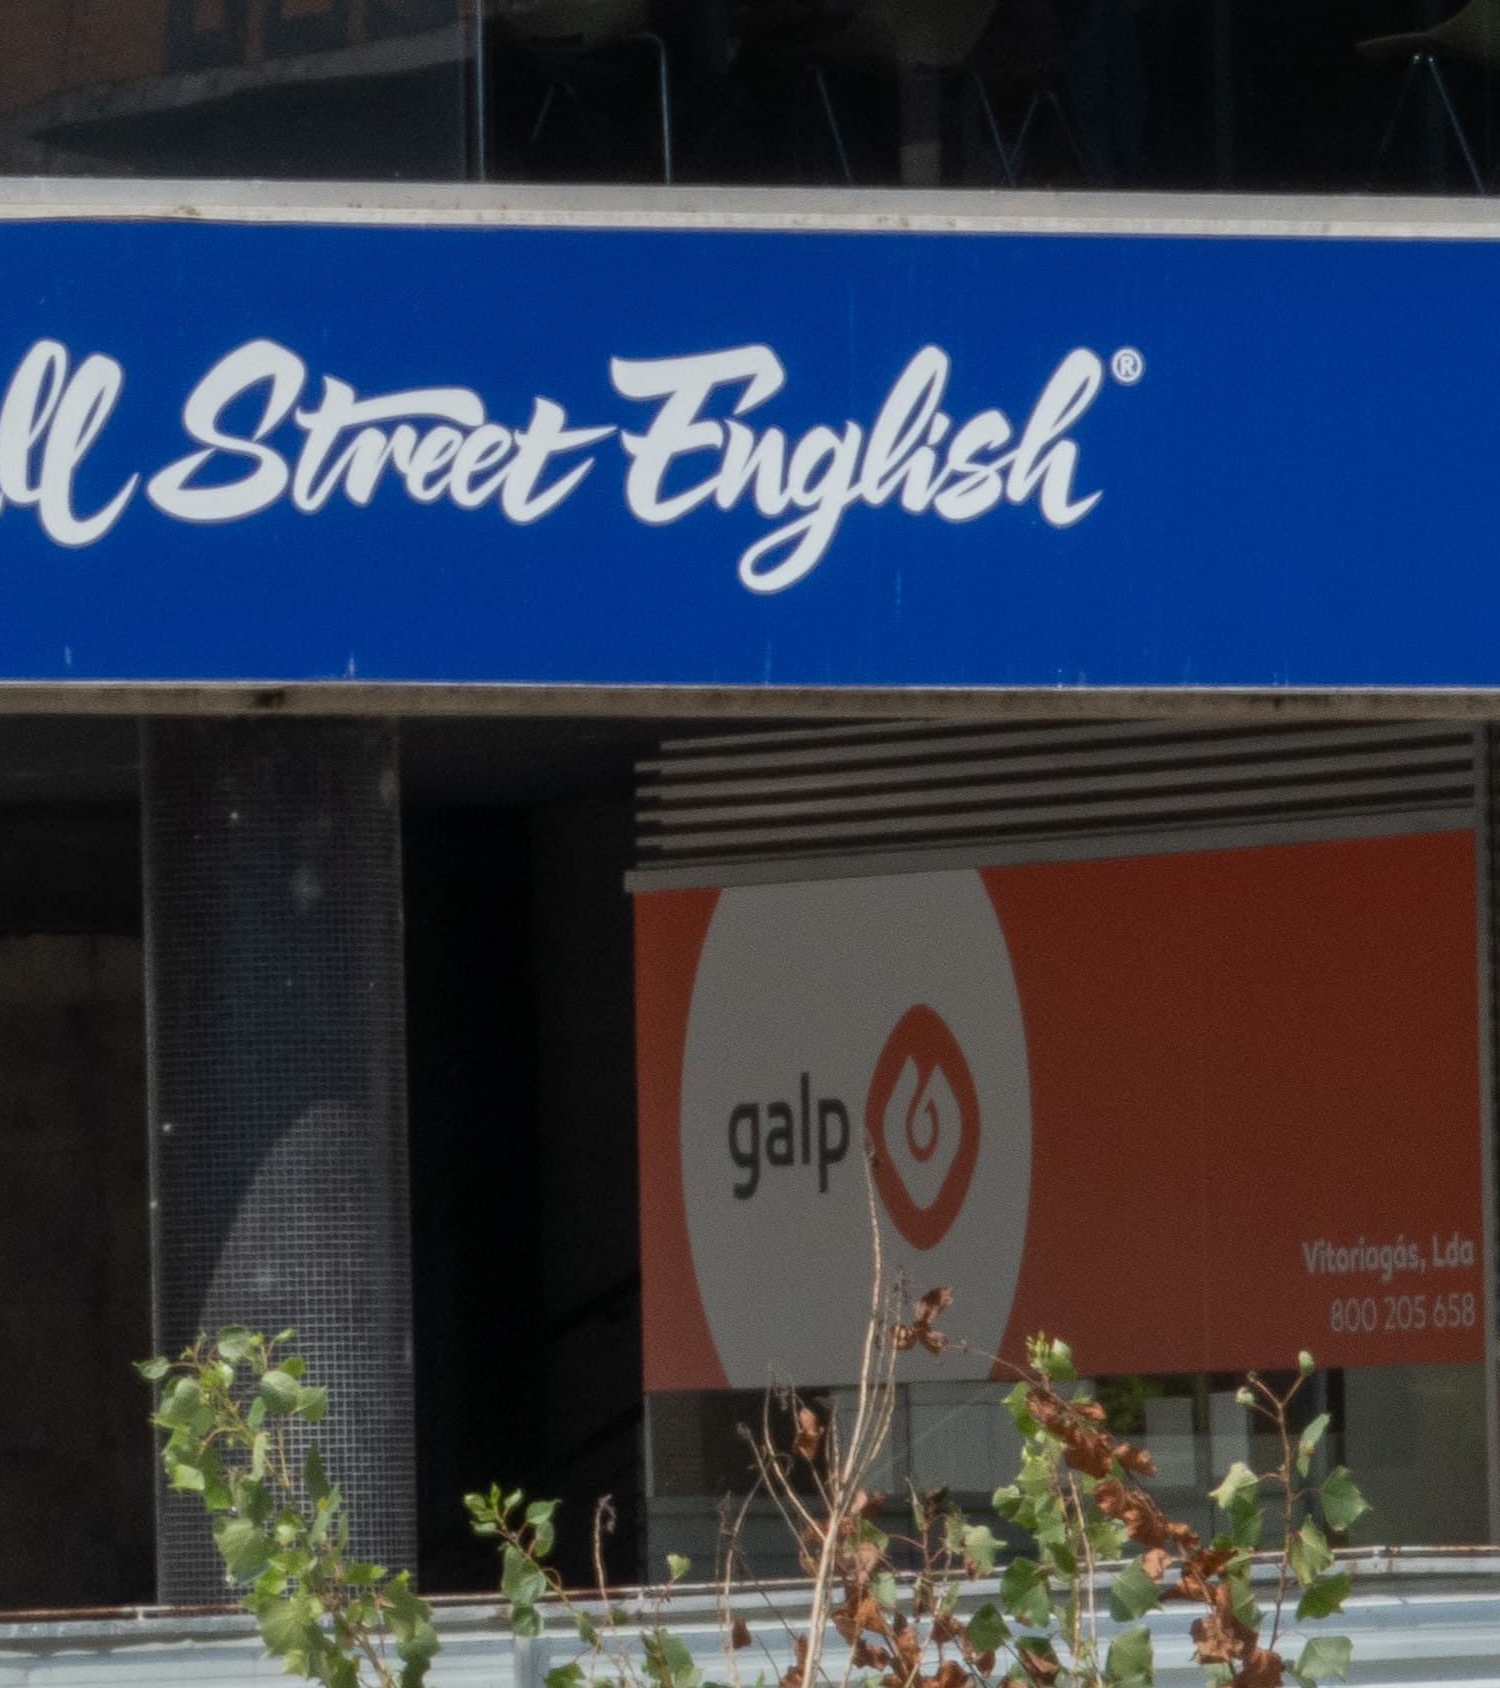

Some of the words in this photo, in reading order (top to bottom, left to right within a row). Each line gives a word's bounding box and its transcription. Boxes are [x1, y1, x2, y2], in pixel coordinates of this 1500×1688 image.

[146, 337, 617, 524] Street
[728, 1072, 850, 1200] galp
[1302, 1234, 1426, 1283] Vitoriagás,
[1431, 1231, 1475, 1268] Lda
[1330, 1297, 1378, 1332] 800
[1384, 1294, 1427, 1331] 205
[1434, 1291, 1476, 1328] 658
